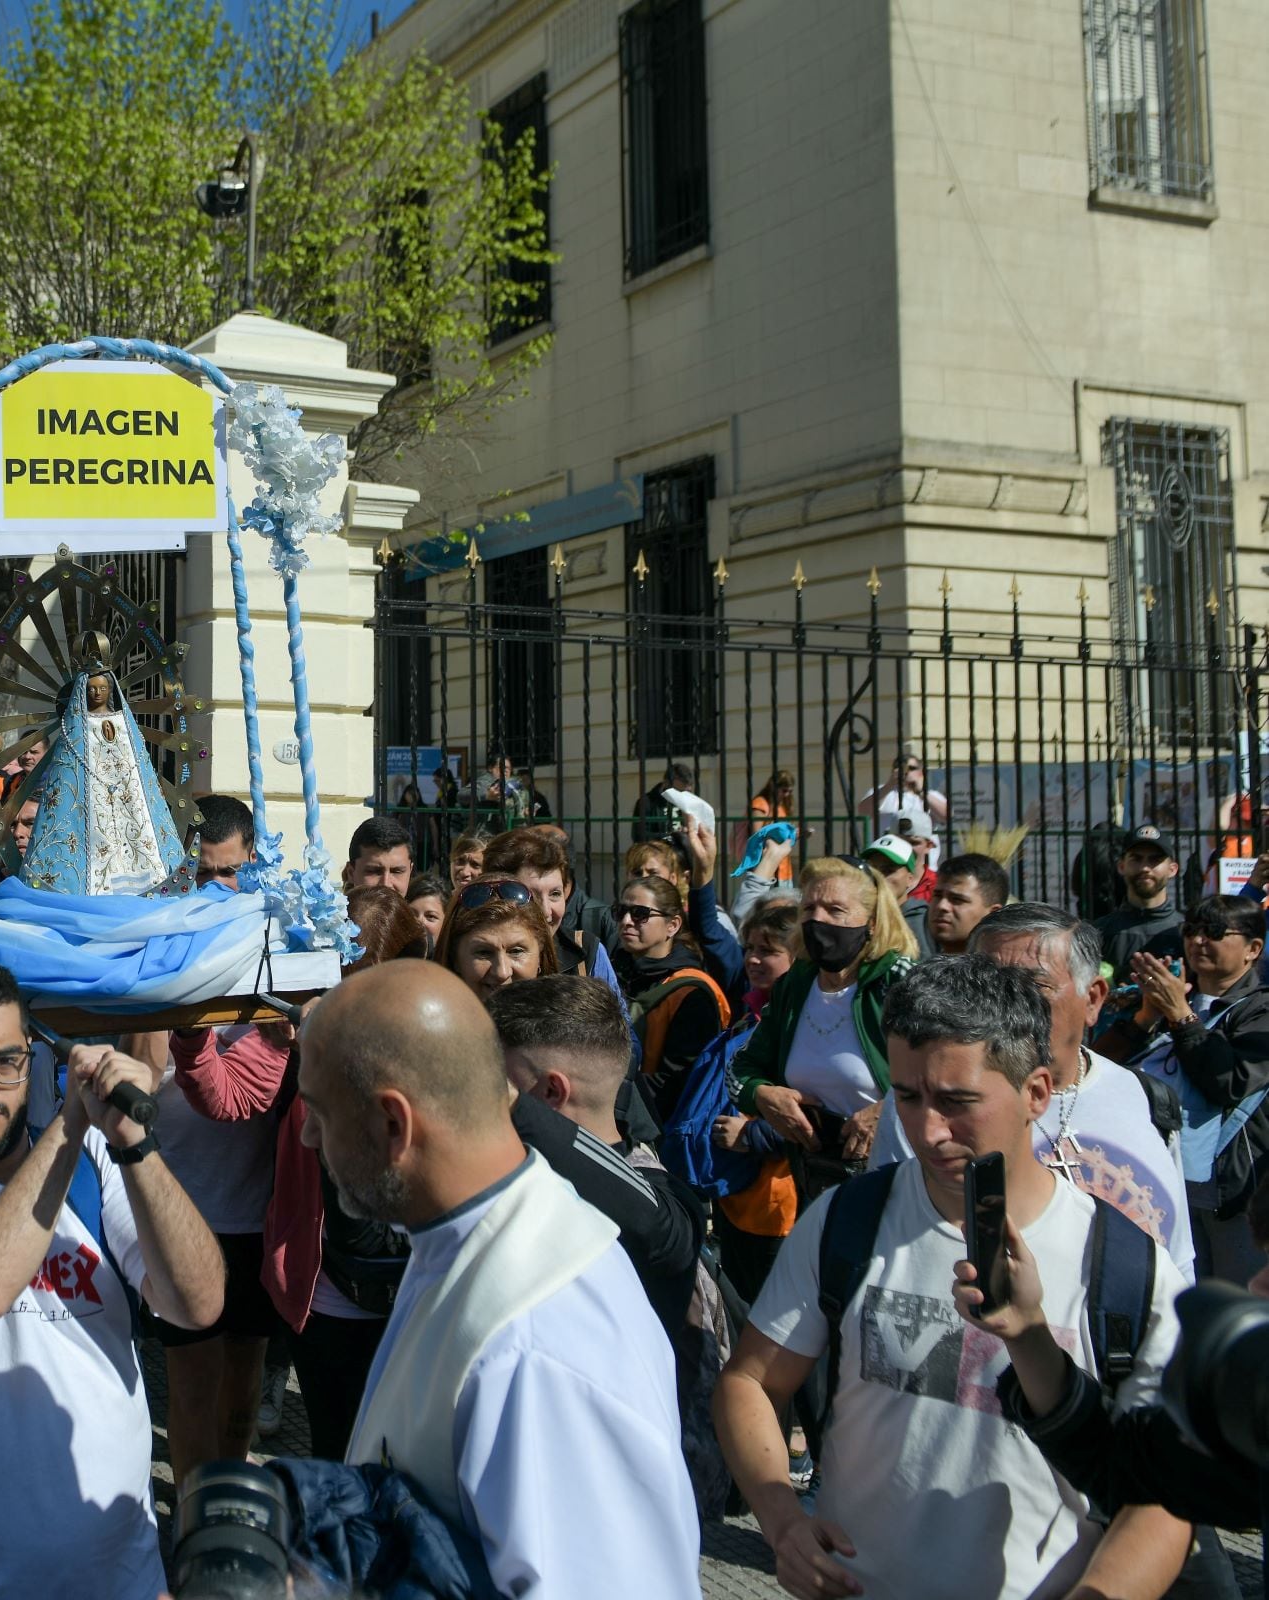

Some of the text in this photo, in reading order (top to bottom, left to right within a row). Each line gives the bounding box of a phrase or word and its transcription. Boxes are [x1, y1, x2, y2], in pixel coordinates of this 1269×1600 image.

[37, 408, 179, 436] IMAGEN
[5, 458, 215, 485] PEREGRINA
[282, 743, 301, 760] 158
[180, 761, 191, 785] villa
[30, 1243, 103, 1306] EX
